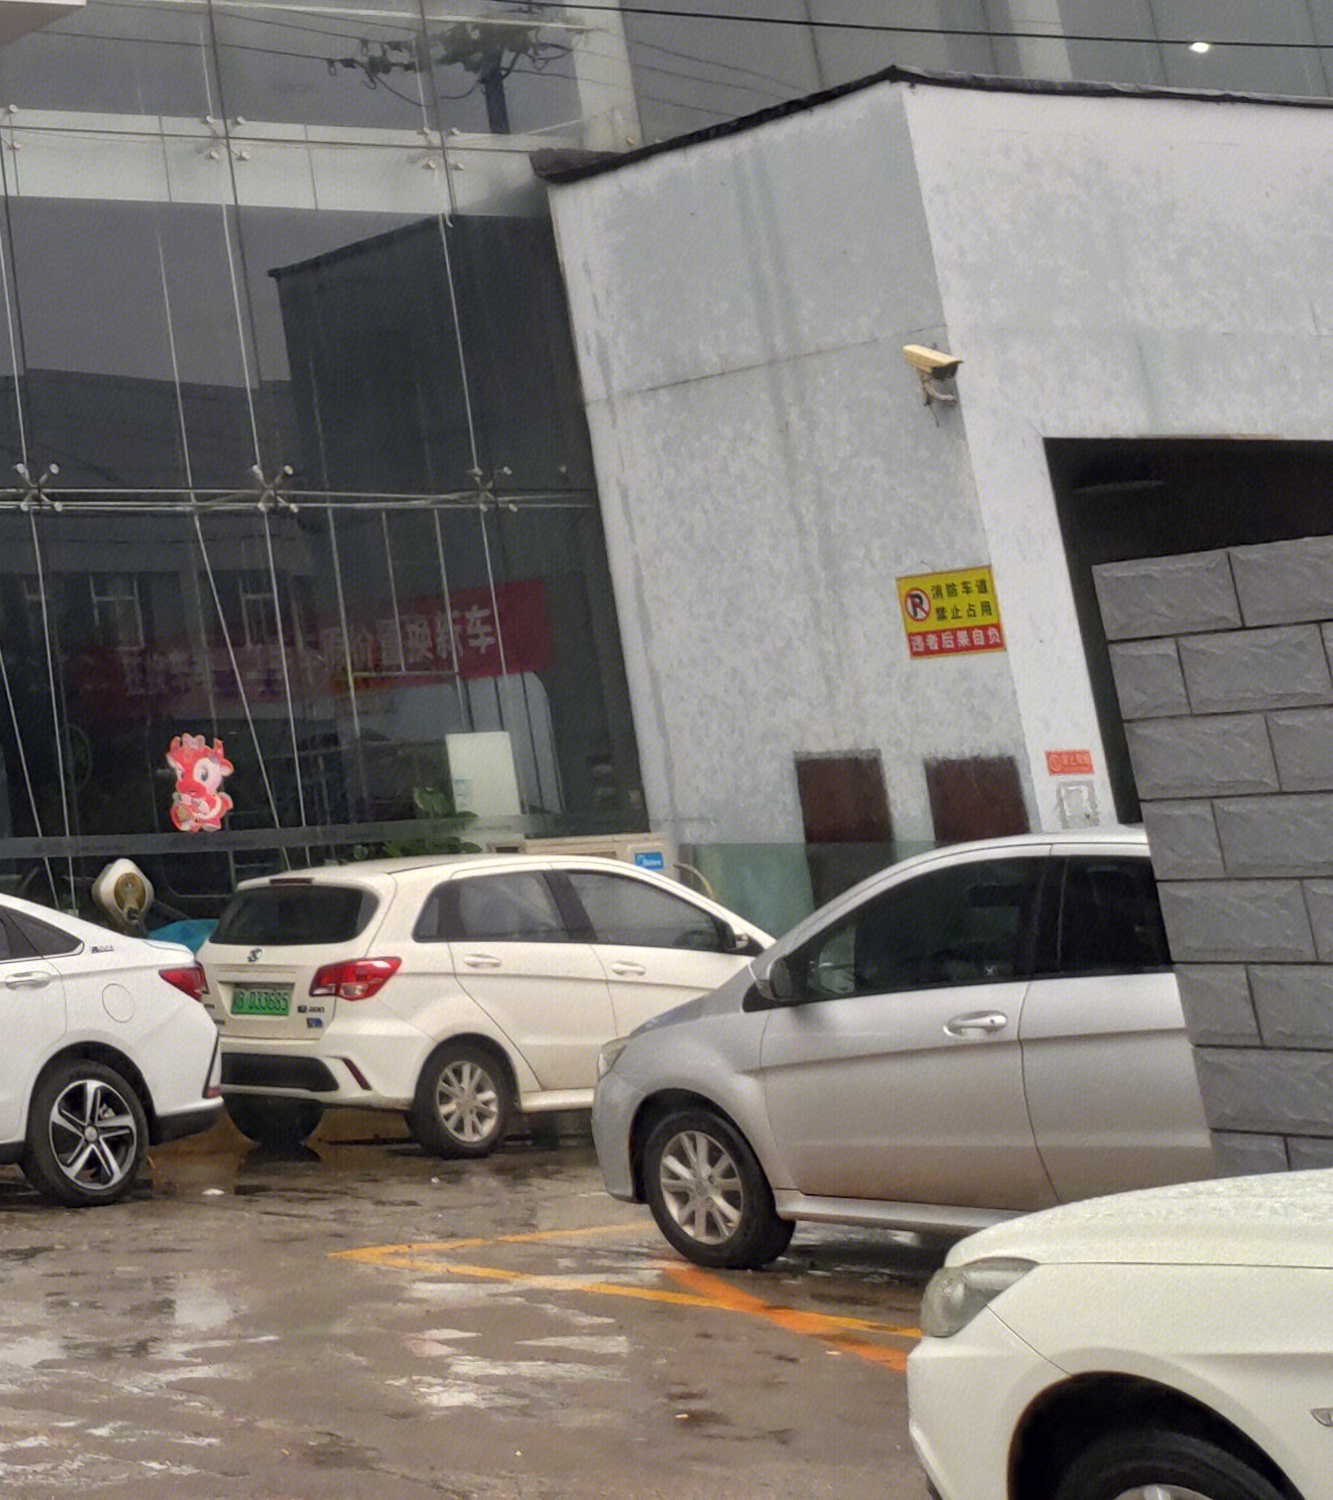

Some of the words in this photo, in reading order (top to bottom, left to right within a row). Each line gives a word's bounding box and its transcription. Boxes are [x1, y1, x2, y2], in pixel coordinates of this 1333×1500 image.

[931, 578, 989, 600] 消防车道
[935, 601, 993, 621] 禁止占用
